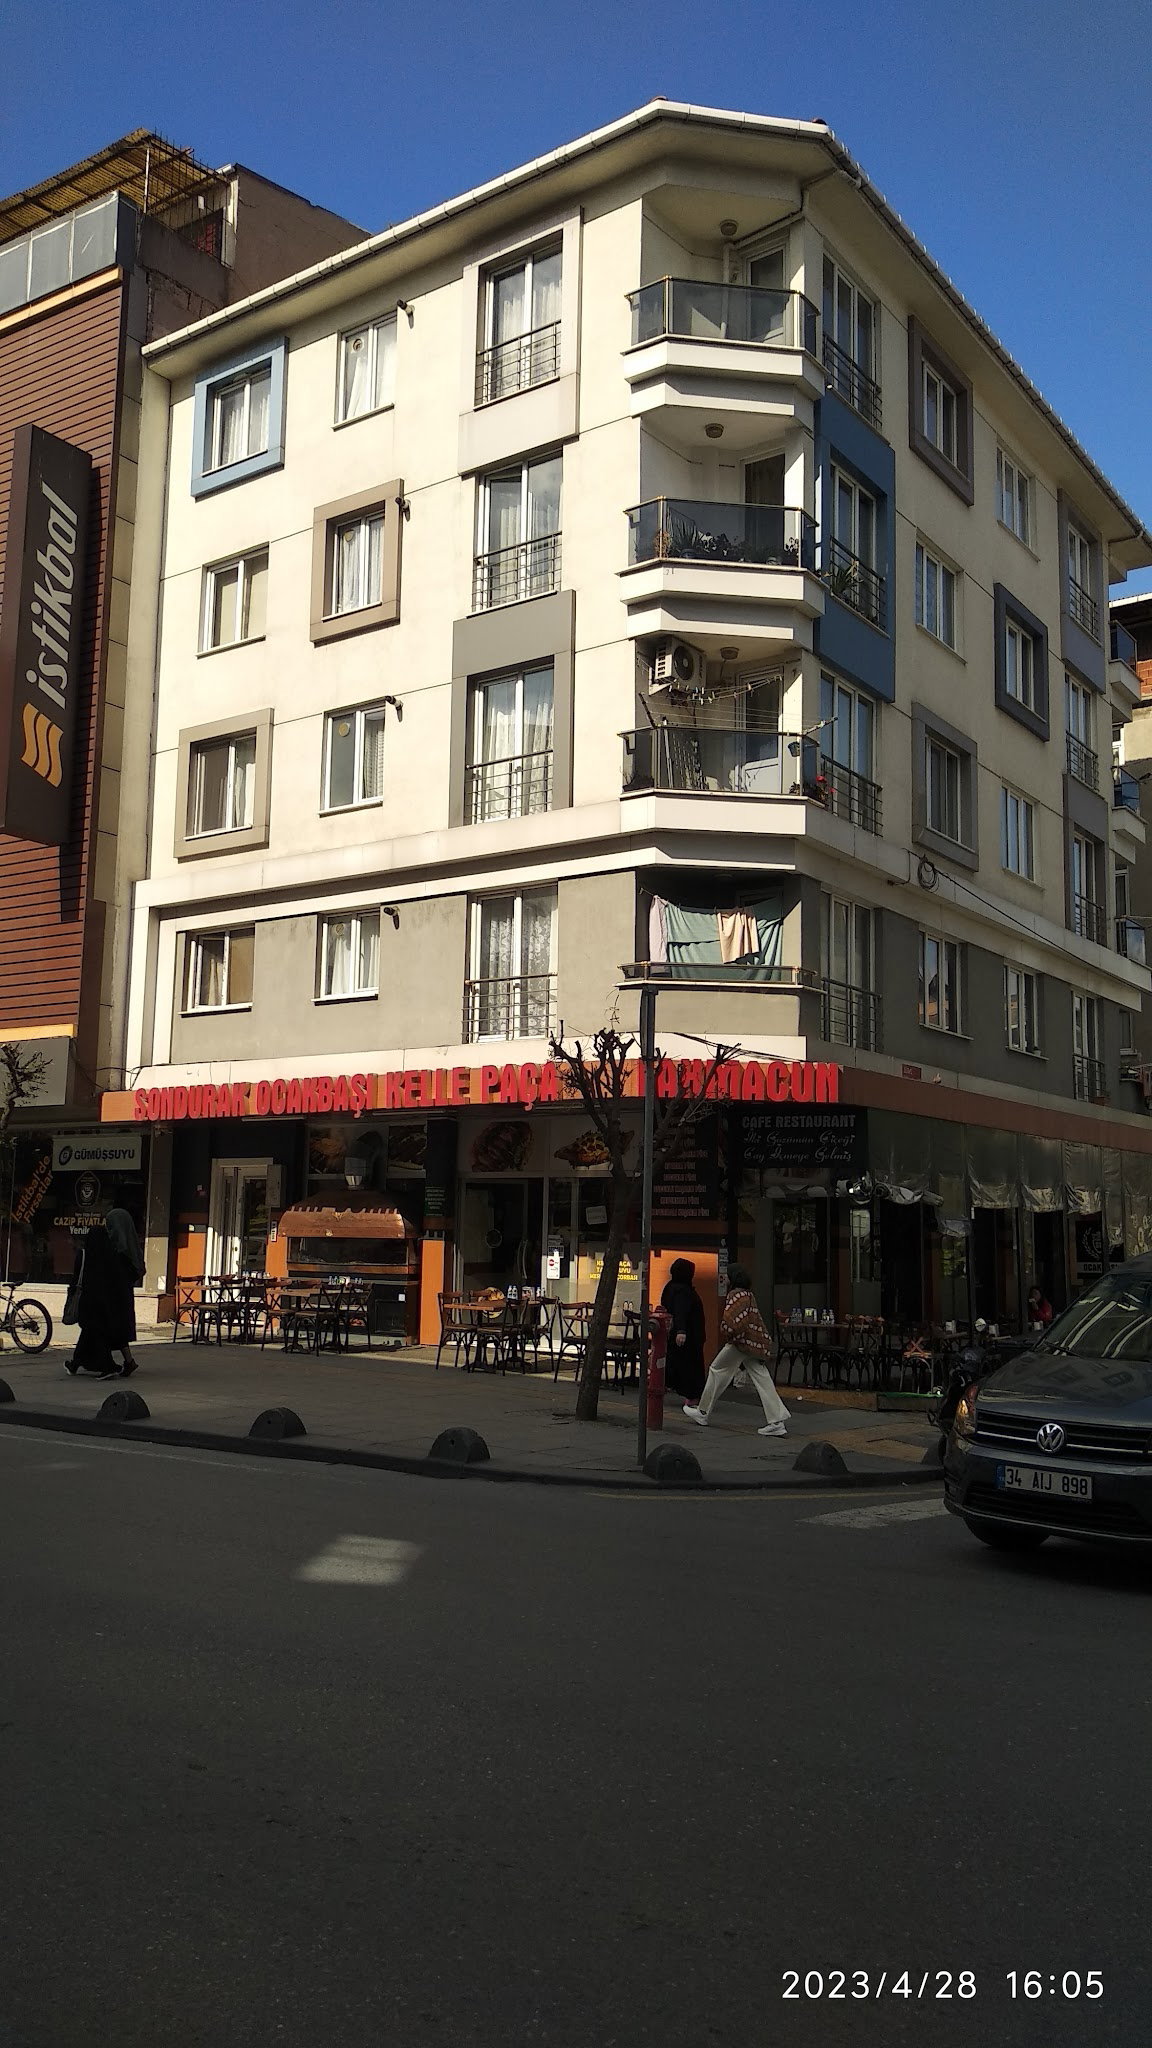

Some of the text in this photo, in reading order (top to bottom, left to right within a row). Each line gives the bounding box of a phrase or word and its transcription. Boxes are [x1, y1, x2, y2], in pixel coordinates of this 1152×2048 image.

[26, 480, 78, 710] istikbal
[134, 1082, 249, 1120] SONDURAK
[256, 1073, 375, 1118] OCAKBAŞI
[386, 1066, 470, 1109] KELLE
[482, 1061, 559, 1111] PAÇA
[742, 1114, 856, 1128] CAFE RESTAURANT
[74, 1148, 135, 1162] GÜMÜŞSUYU
[1006, 1468, 1088, 1495] 34 AIJ 898
